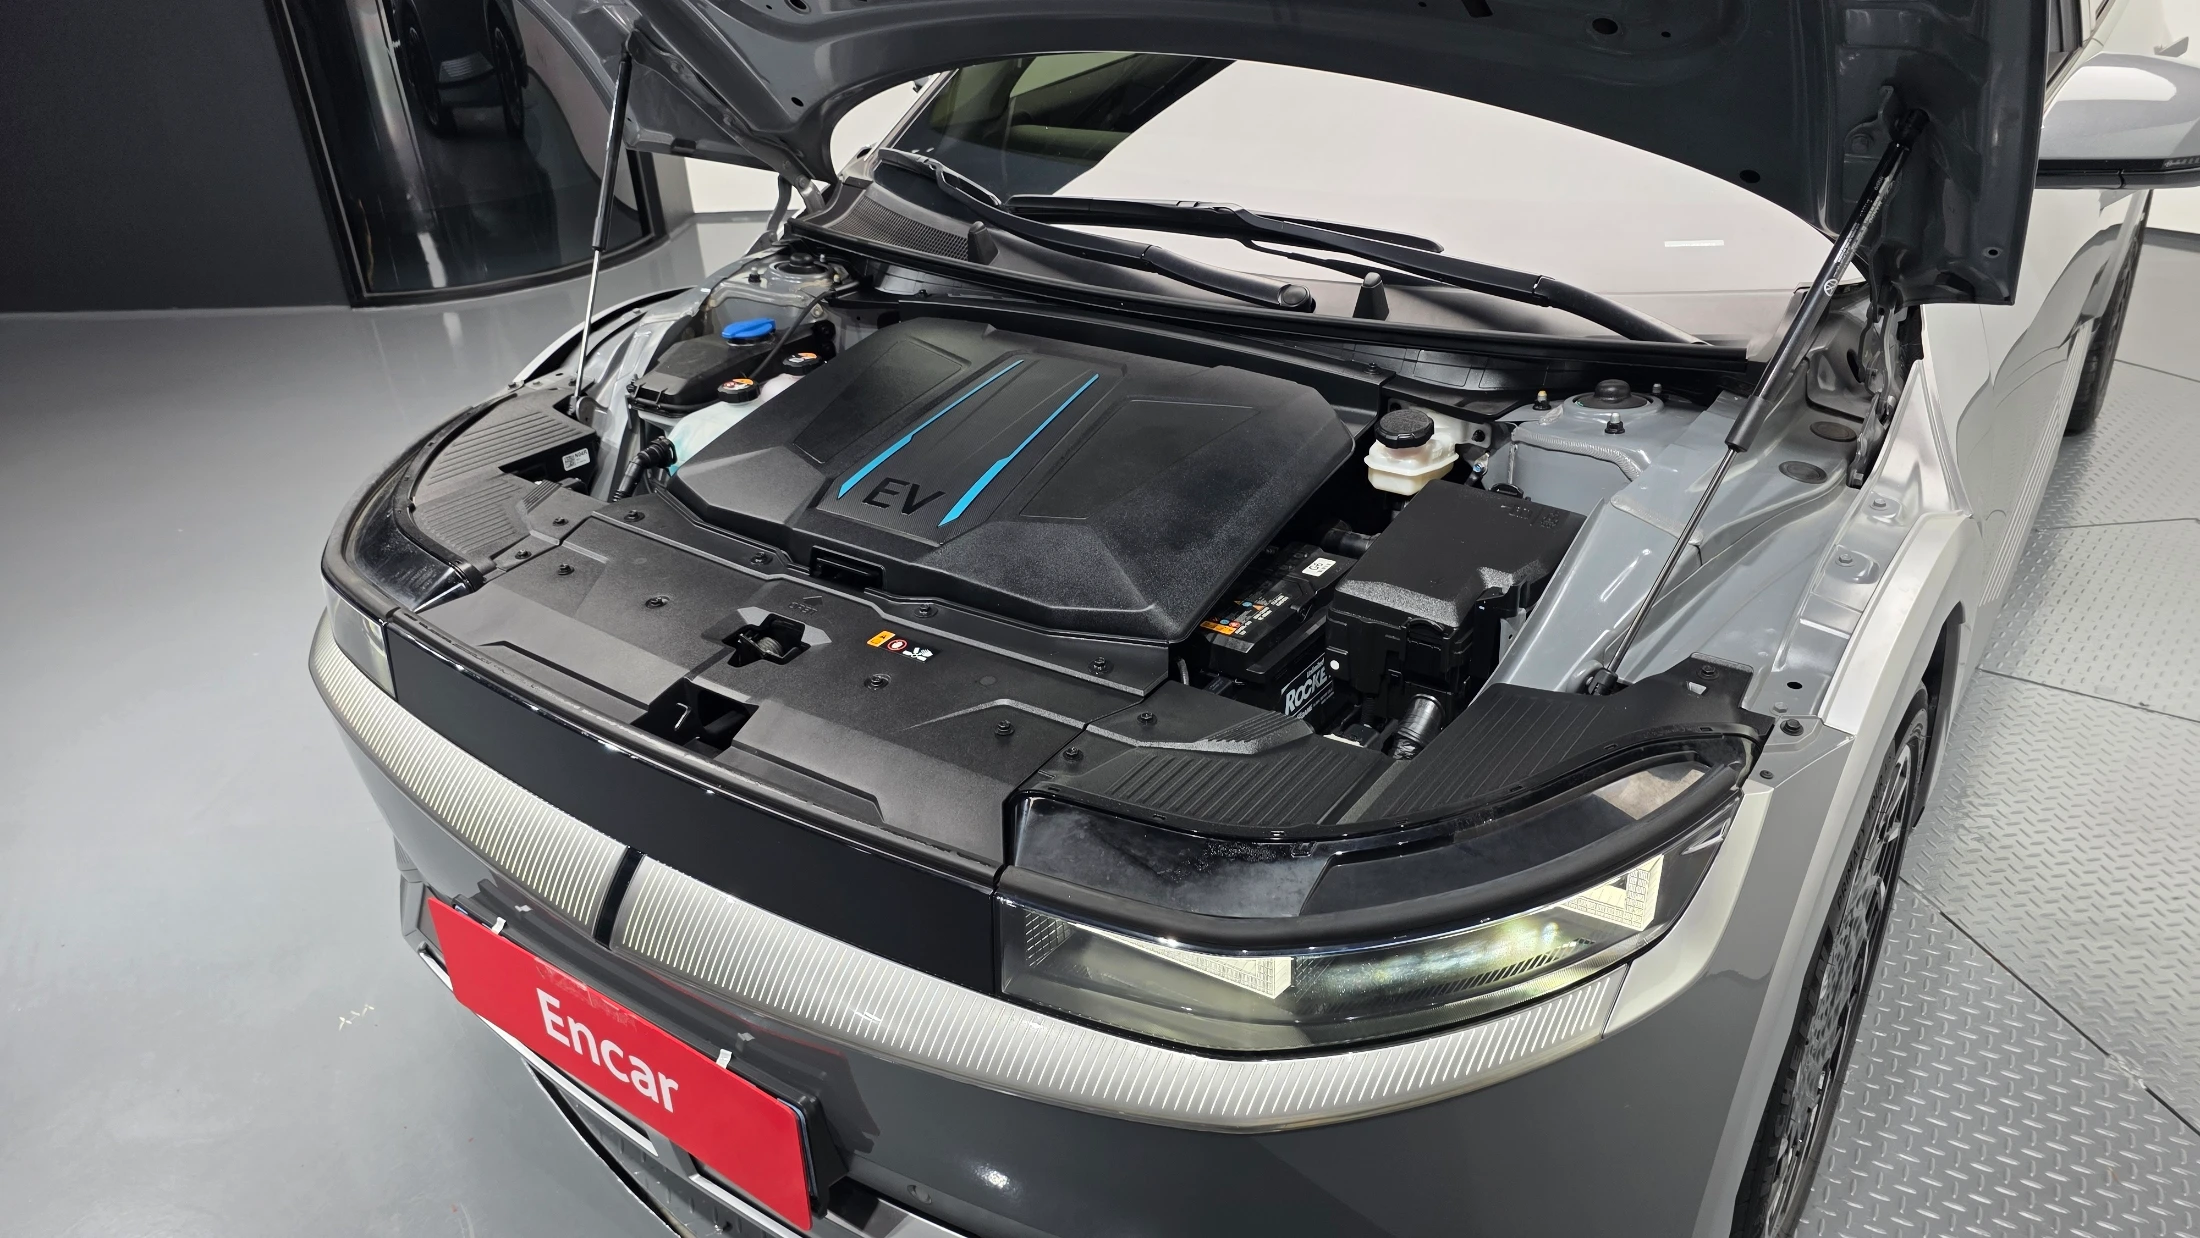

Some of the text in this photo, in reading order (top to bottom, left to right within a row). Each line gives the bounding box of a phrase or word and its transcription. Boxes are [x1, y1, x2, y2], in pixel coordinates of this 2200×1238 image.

[862, 477, 946, 516] EV
[1284, 666, 1331, 716] ROCKE
[1837, 825, 1865, 910] PRIMACY
[1866, 775, 1884, 820] TOUR
[536, 988, 680, 1113] Encar
